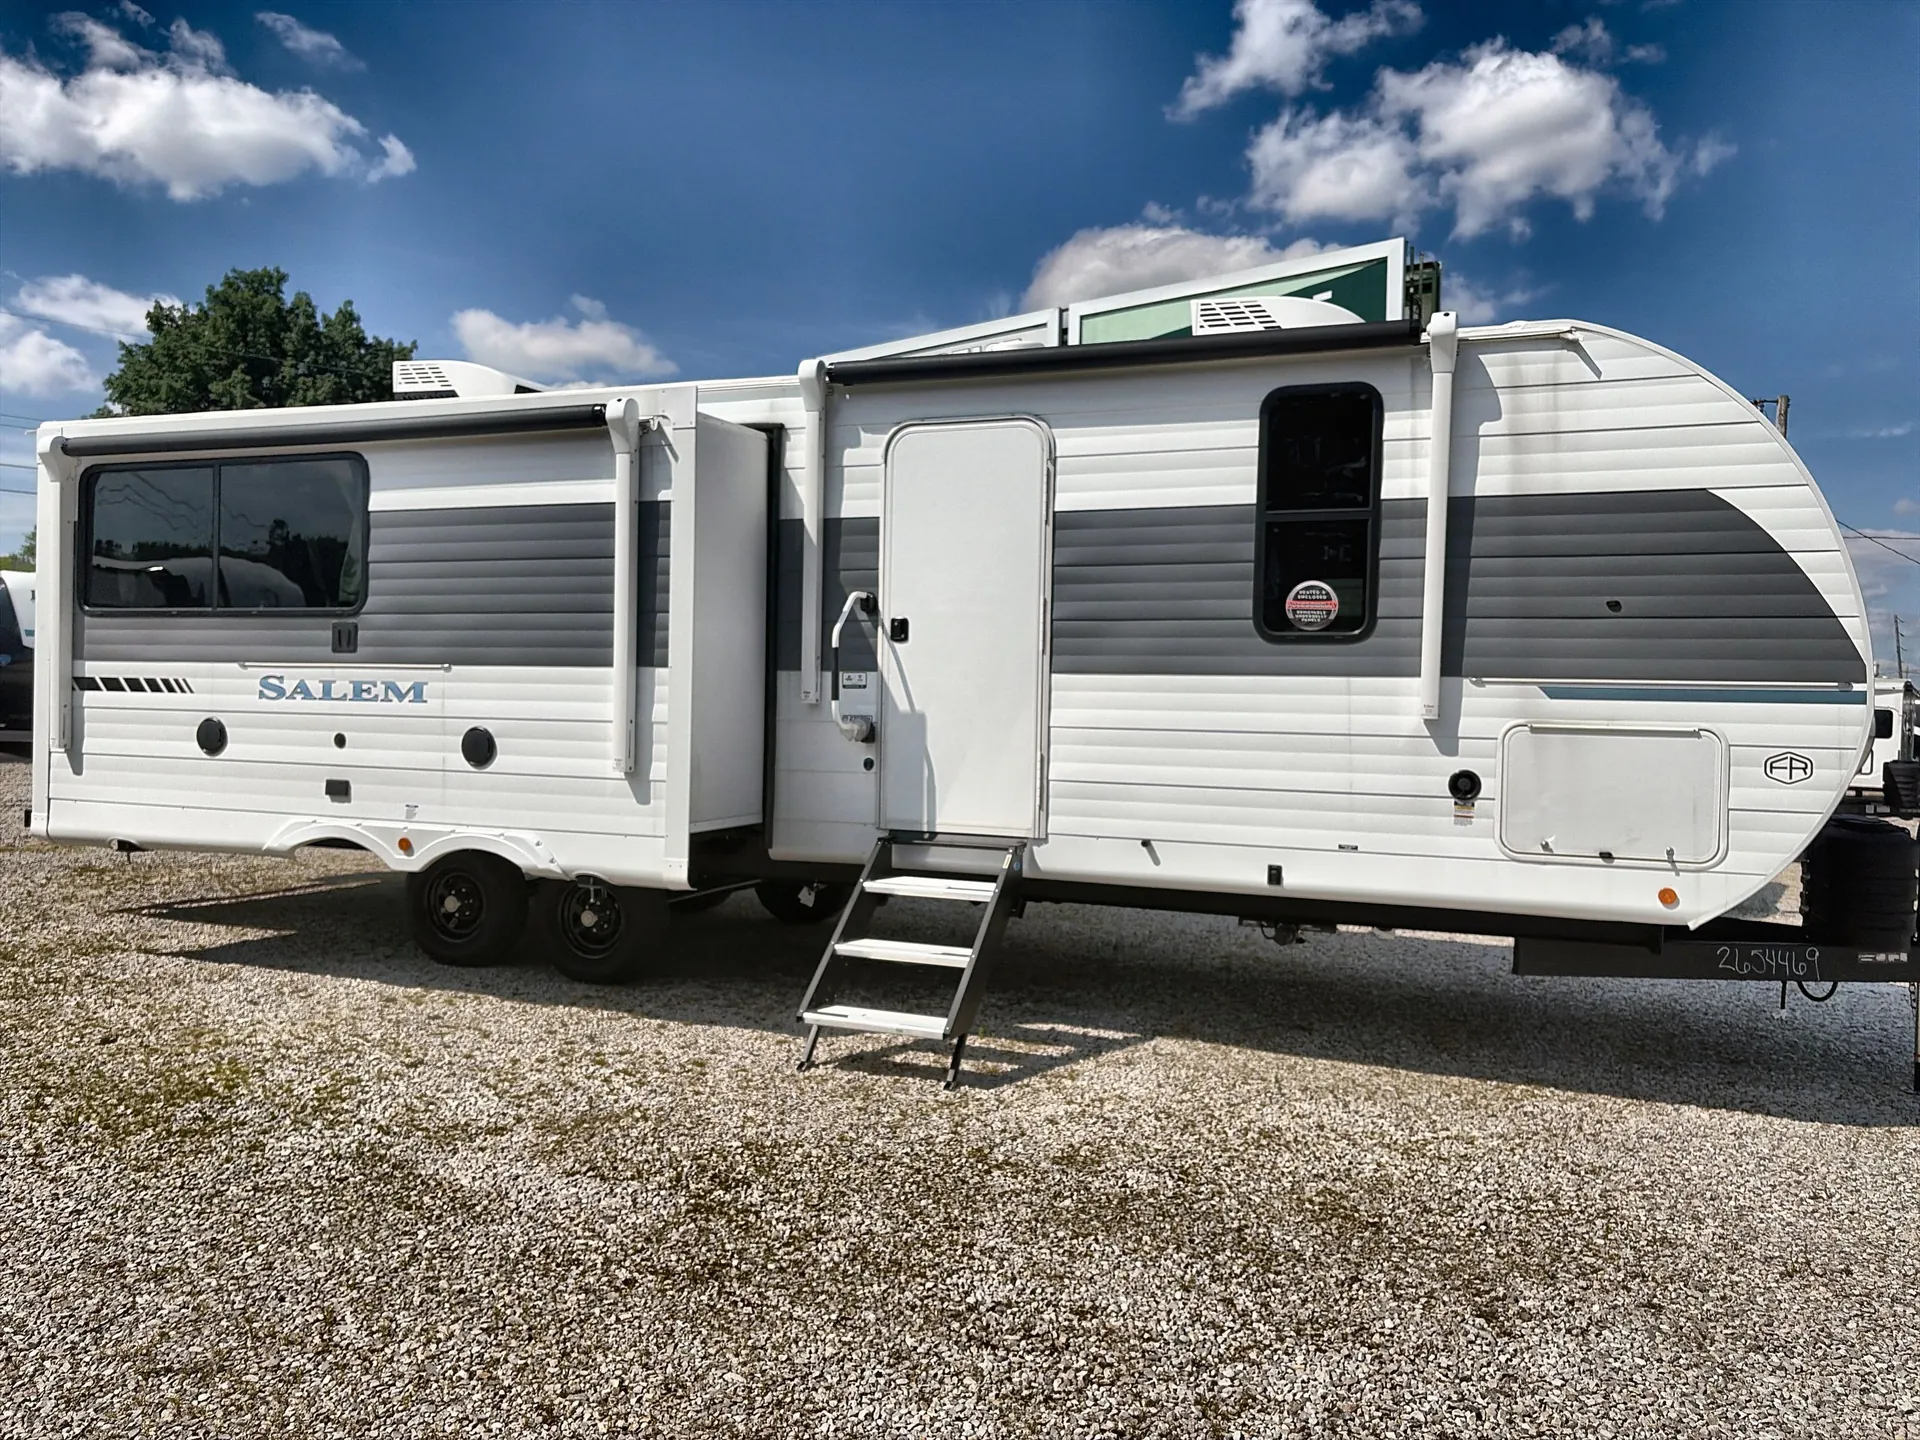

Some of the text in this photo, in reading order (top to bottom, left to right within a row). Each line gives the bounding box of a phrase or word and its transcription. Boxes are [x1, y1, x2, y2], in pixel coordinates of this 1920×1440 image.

[258, 675, 429, 704] SALEM
[1769, 756, 1808, 781] FR
[1717, 946, 1820, 981] 2654469
